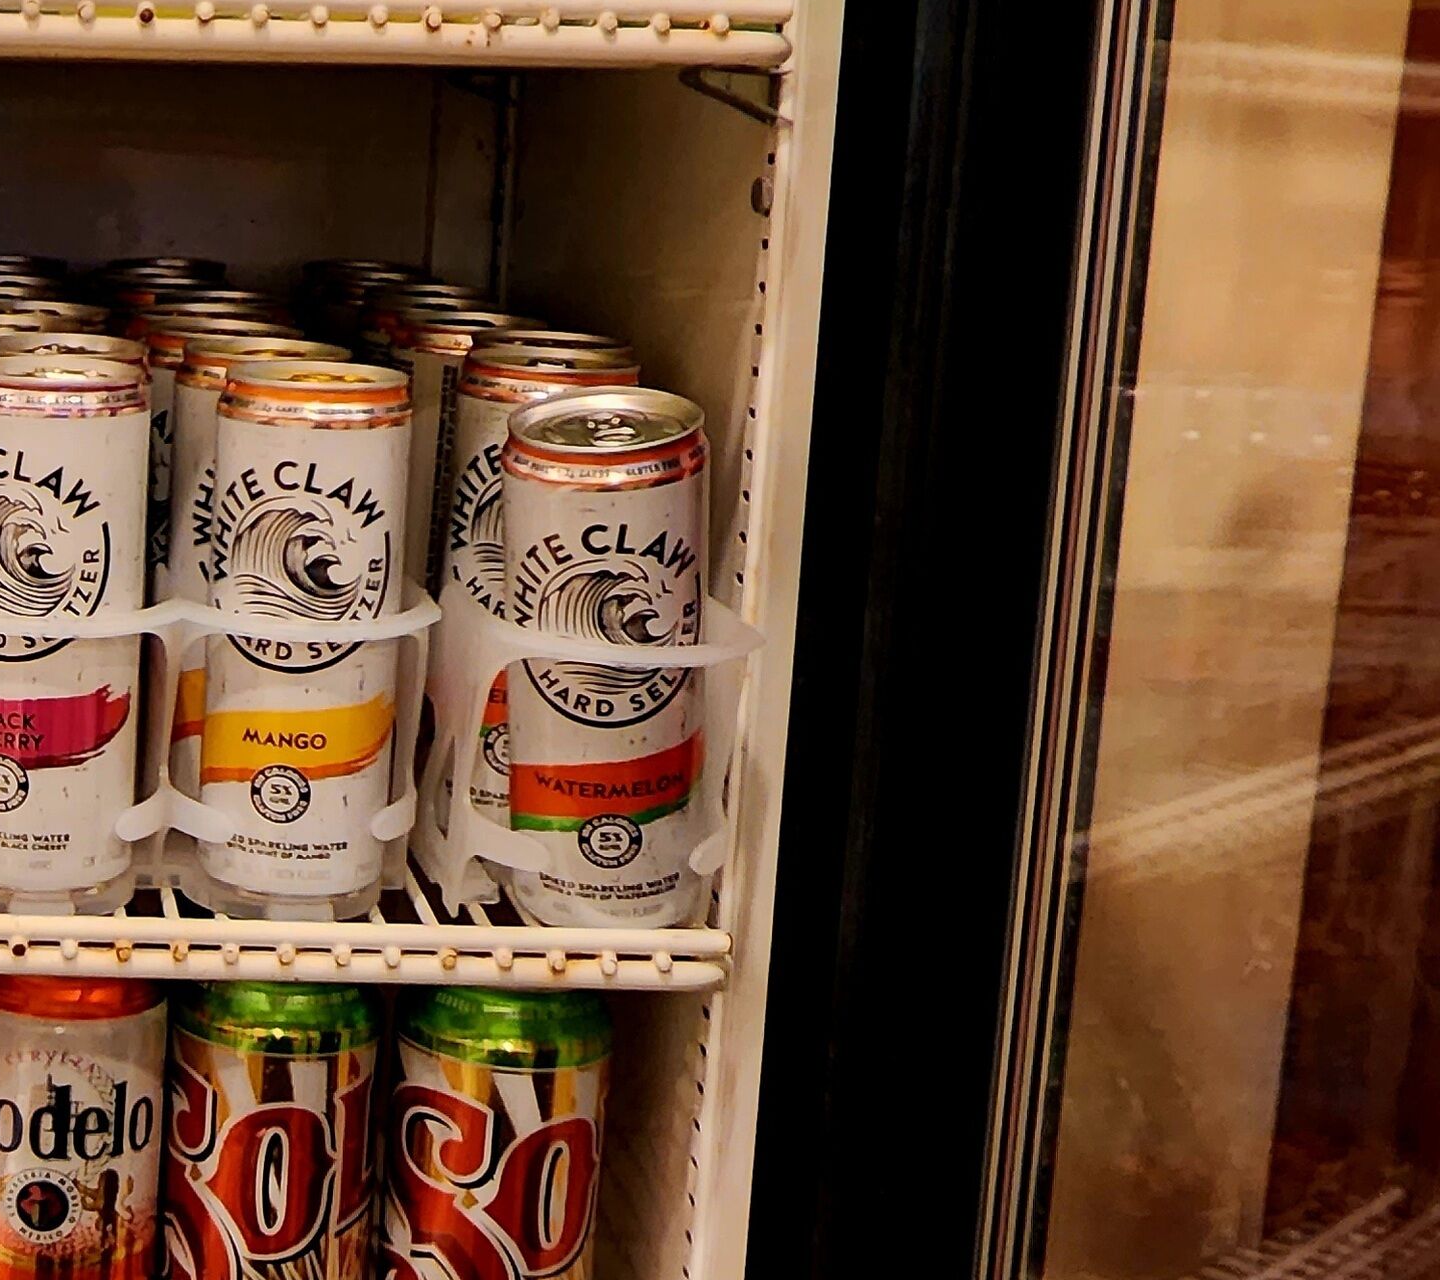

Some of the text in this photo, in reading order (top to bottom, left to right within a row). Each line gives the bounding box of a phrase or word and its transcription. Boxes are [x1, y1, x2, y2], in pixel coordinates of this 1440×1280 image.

[212, 467, 265, 581] WHITE
[273, 460, 385, 529] CLAW
[450, 443, 503, 552] WHITE
[512, 523, 697, 628] WHITE CLAW
[537, 668, 615, 717] HARD
[241, 727, 328, 751] MANGO
[535, 770, 685, 800] WATERMELON
